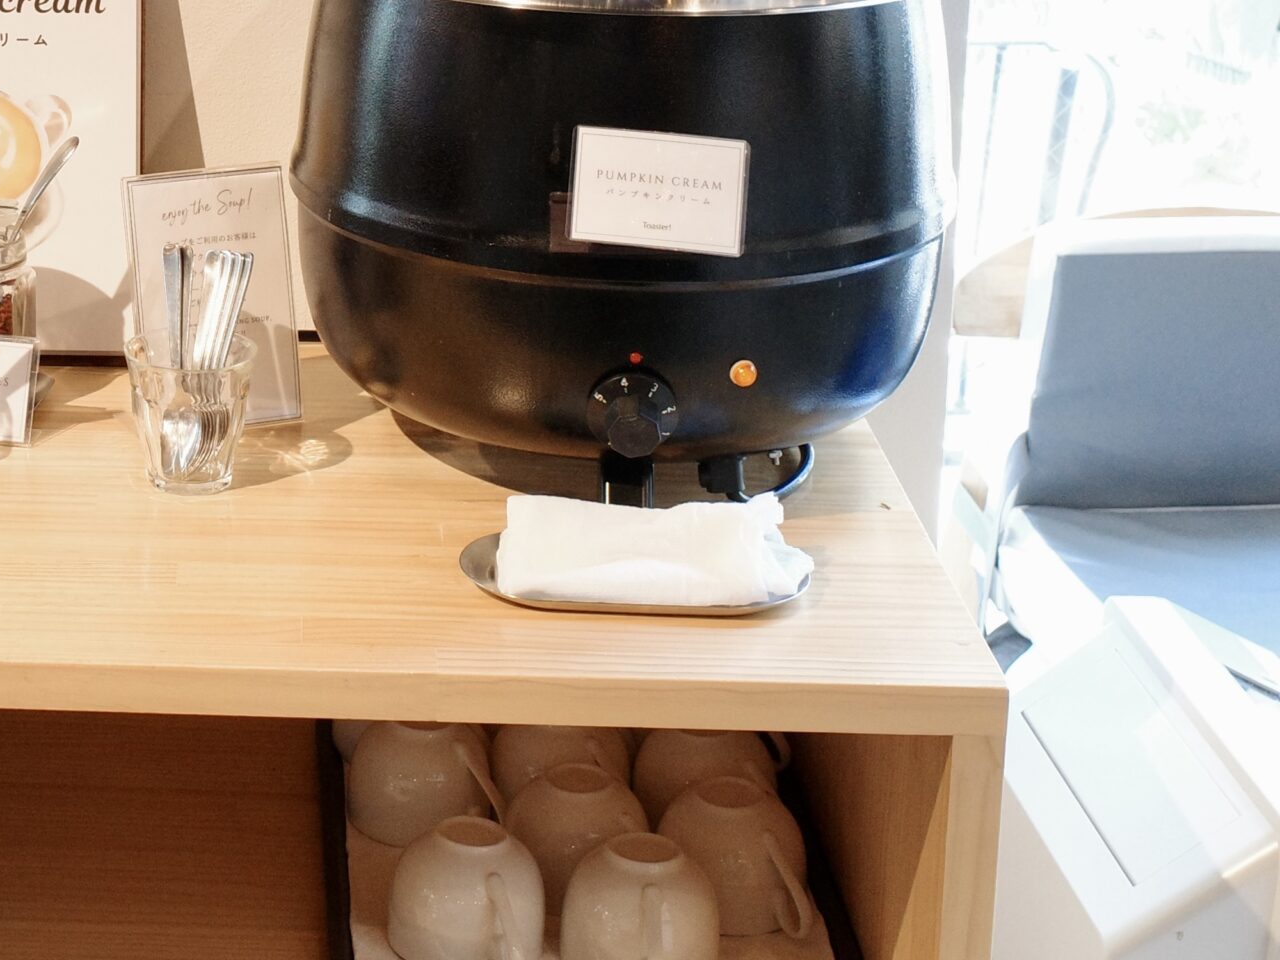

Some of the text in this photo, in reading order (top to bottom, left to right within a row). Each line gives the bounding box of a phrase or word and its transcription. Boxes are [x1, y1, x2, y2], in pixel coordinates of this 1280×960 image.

[596, 169, 723, 191] PUMPKIN CREAM
[190, 198, 211, 215] the
[643, 221, 672, 232] Toaster!
[620, 377, 629, 387] 4
[650, 382, 659, 392] 3
[593, 391, 604, 401] 5
